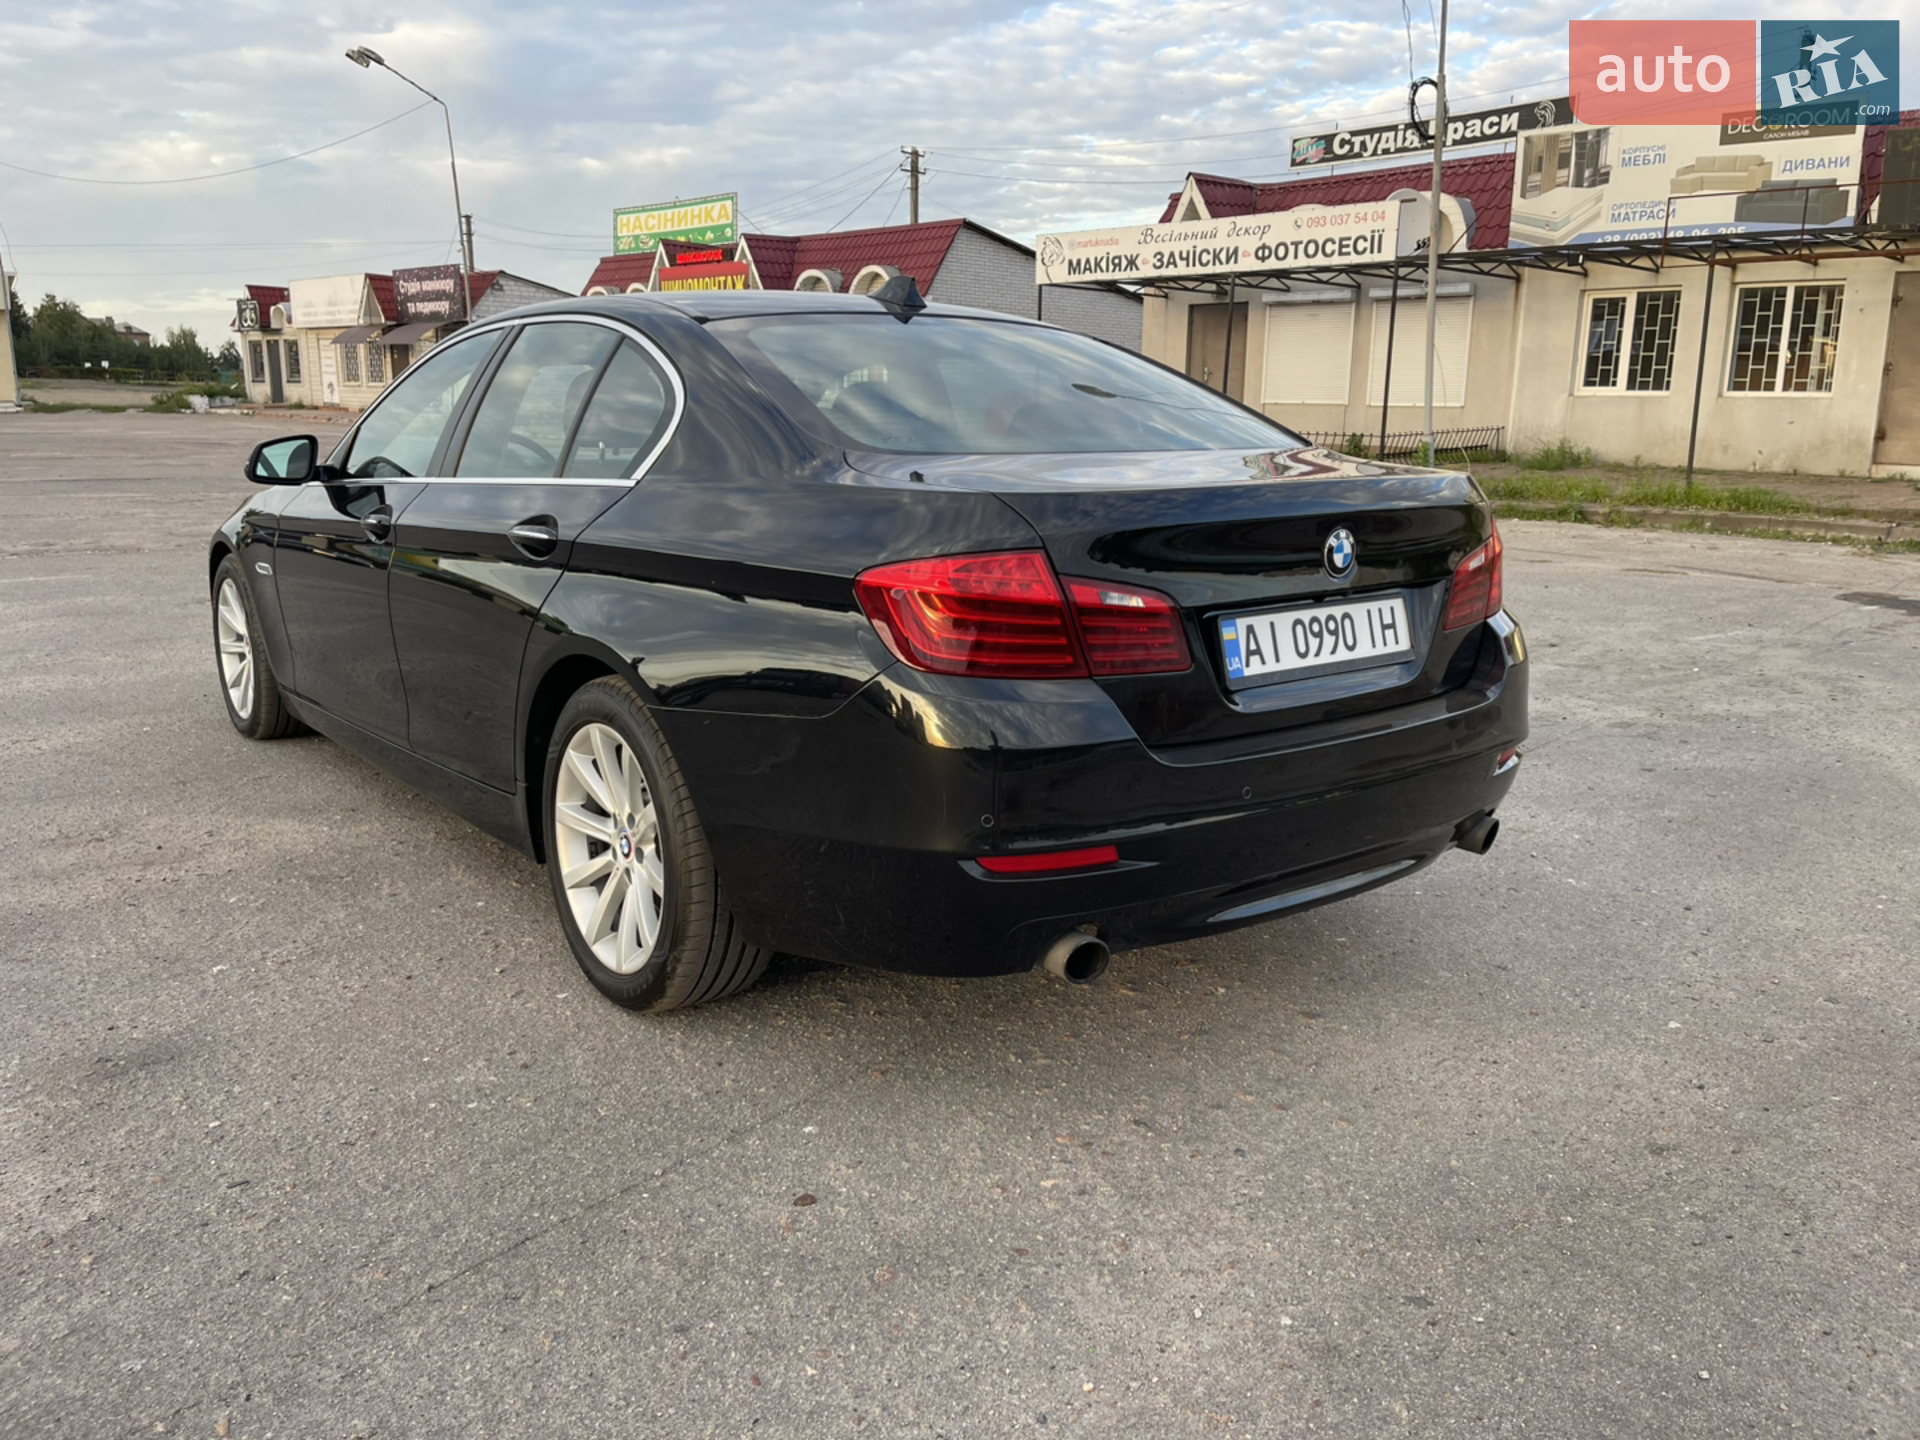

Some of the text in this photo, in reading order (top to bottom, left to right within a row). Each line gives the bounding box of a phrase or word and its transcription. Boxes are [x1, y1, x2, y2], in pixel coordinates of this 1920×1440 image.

[1332, 124, 1421, 157] Студія
[1622, 144, 1667, 155] КОРПУСНІ
[1621, 153, 1667, 168] МЕБЛІ
[1781, 155, 1851, 174] ДИВАНИ
[618, 202, 730, 235] НАСІНИНКА
[1306, 210, 1386, 229] 093 037 54 04
[1610, 208, 1677, 224] МАТРАСИ
[1138, 220, 1271, 245] Весільний декор
[1245, 606, 1400, 668] AI 0990 IH
[1227, 656, 1242, 671] UA
